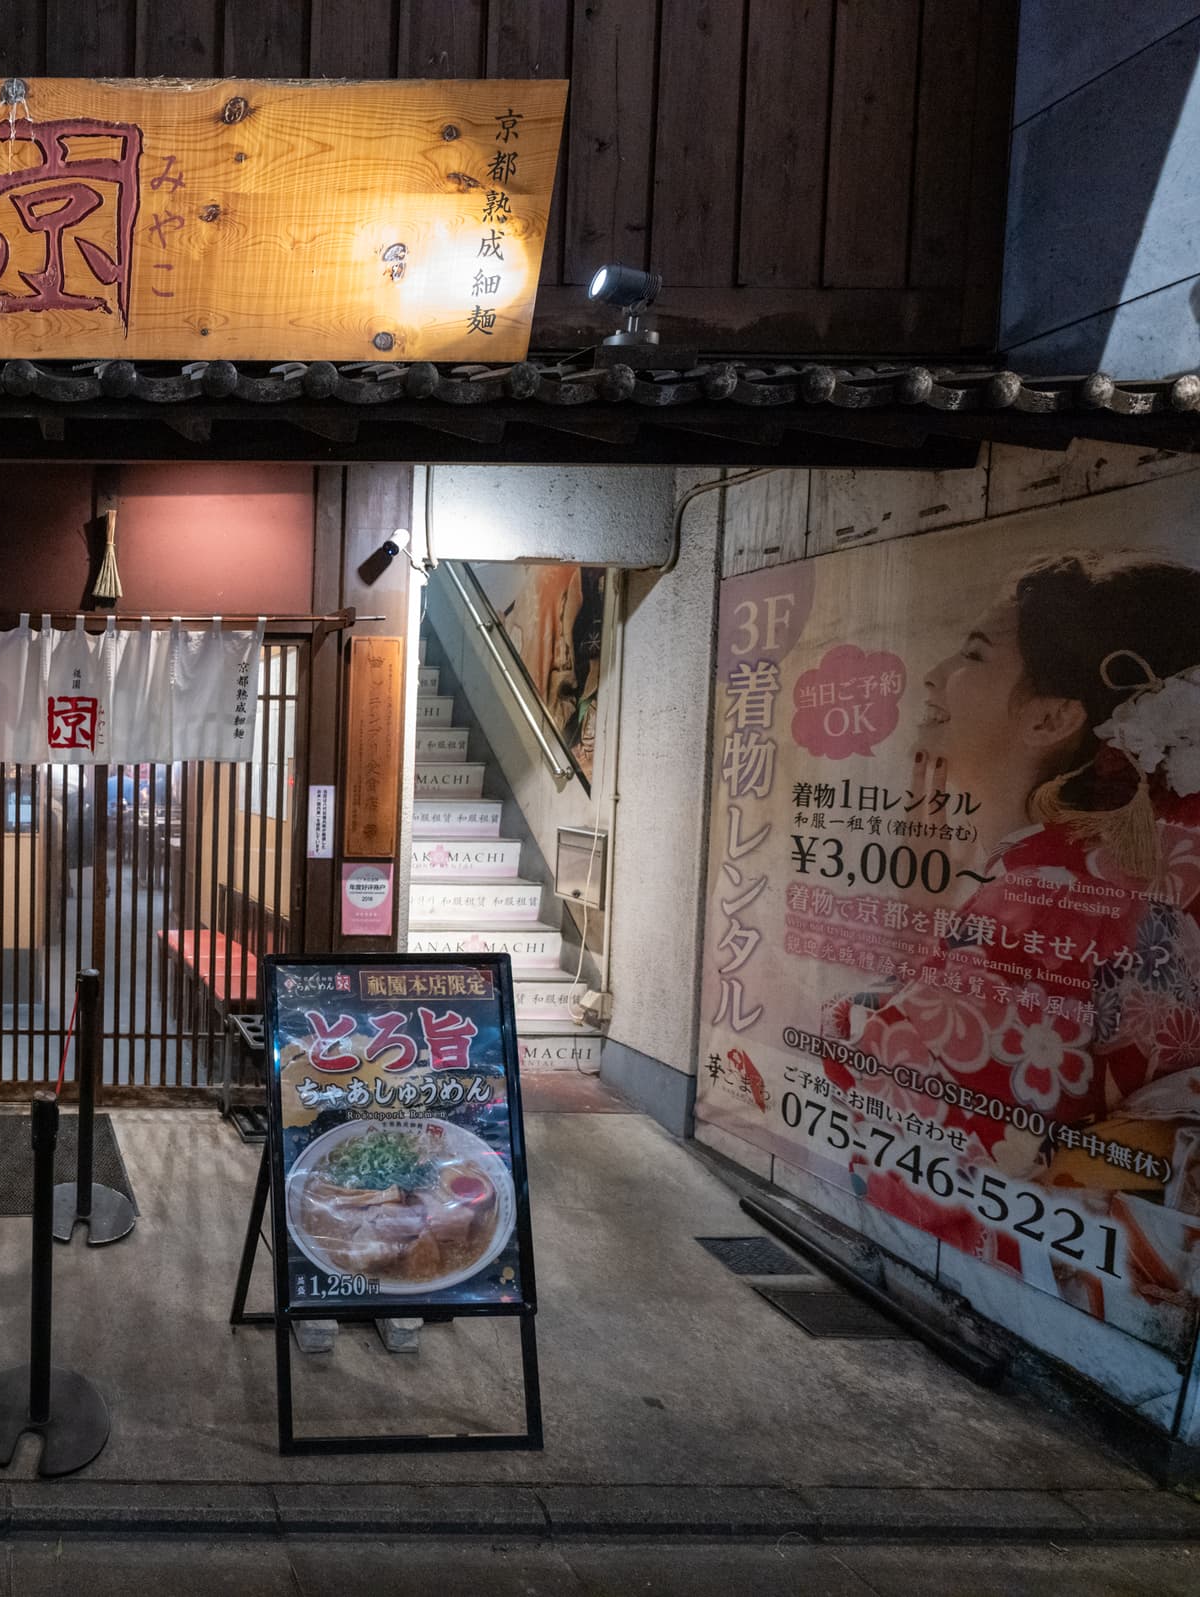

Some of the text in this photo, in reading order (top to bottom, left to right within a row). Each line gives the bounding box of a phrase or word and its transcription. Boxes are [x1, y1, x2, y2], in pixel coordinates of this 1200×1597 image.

[149, 155, 185, 297] みやこ
[467, 108, 524, 335] 京都熟成細麺
[731, 593, 795, 656] 3F
[799, 670, 902, 709] 当日ご予約
[824, 703, 876, 737] OK
[416, 775, 470, 784] MACHI
[791, 778, 982, 816] 着物1日レンタル
[457, 813, 499, 823] 和服租賃
[448, 853, 505, 862] MACHI
[711, 661, 780, 1033] 着物レンタル
[494, 896, 537, 907] 和服租賃
[1004, 873, 1181, 906] One day kimono rental
[1004, 889, 1121, 919] include dressing
[480, 943, 546, 953] MACHI
[788, 885, 1171, 978] 着物で京都を散策しませんか?
[826, 924, 853, 939] trying
[856, 931, 915, 954] sightseeing
[918, 943, 929, 954] in
[932, 945, 968, 964] Kyoto
[1037, 967, 1099, 992] kimono?
[366, 974, 488, 997] 祇園本店限定
[304, 1006, 479, 1073] とろ旨
[524, 1047, 592, 1060] MACHI
[297, 1076, 492, 1108] ちゃあしゅうめん
[783, 1065, 968, 1152] ご予約・お問い合わせ
[782, 1092, 1122, 1279] 075-746-5221
